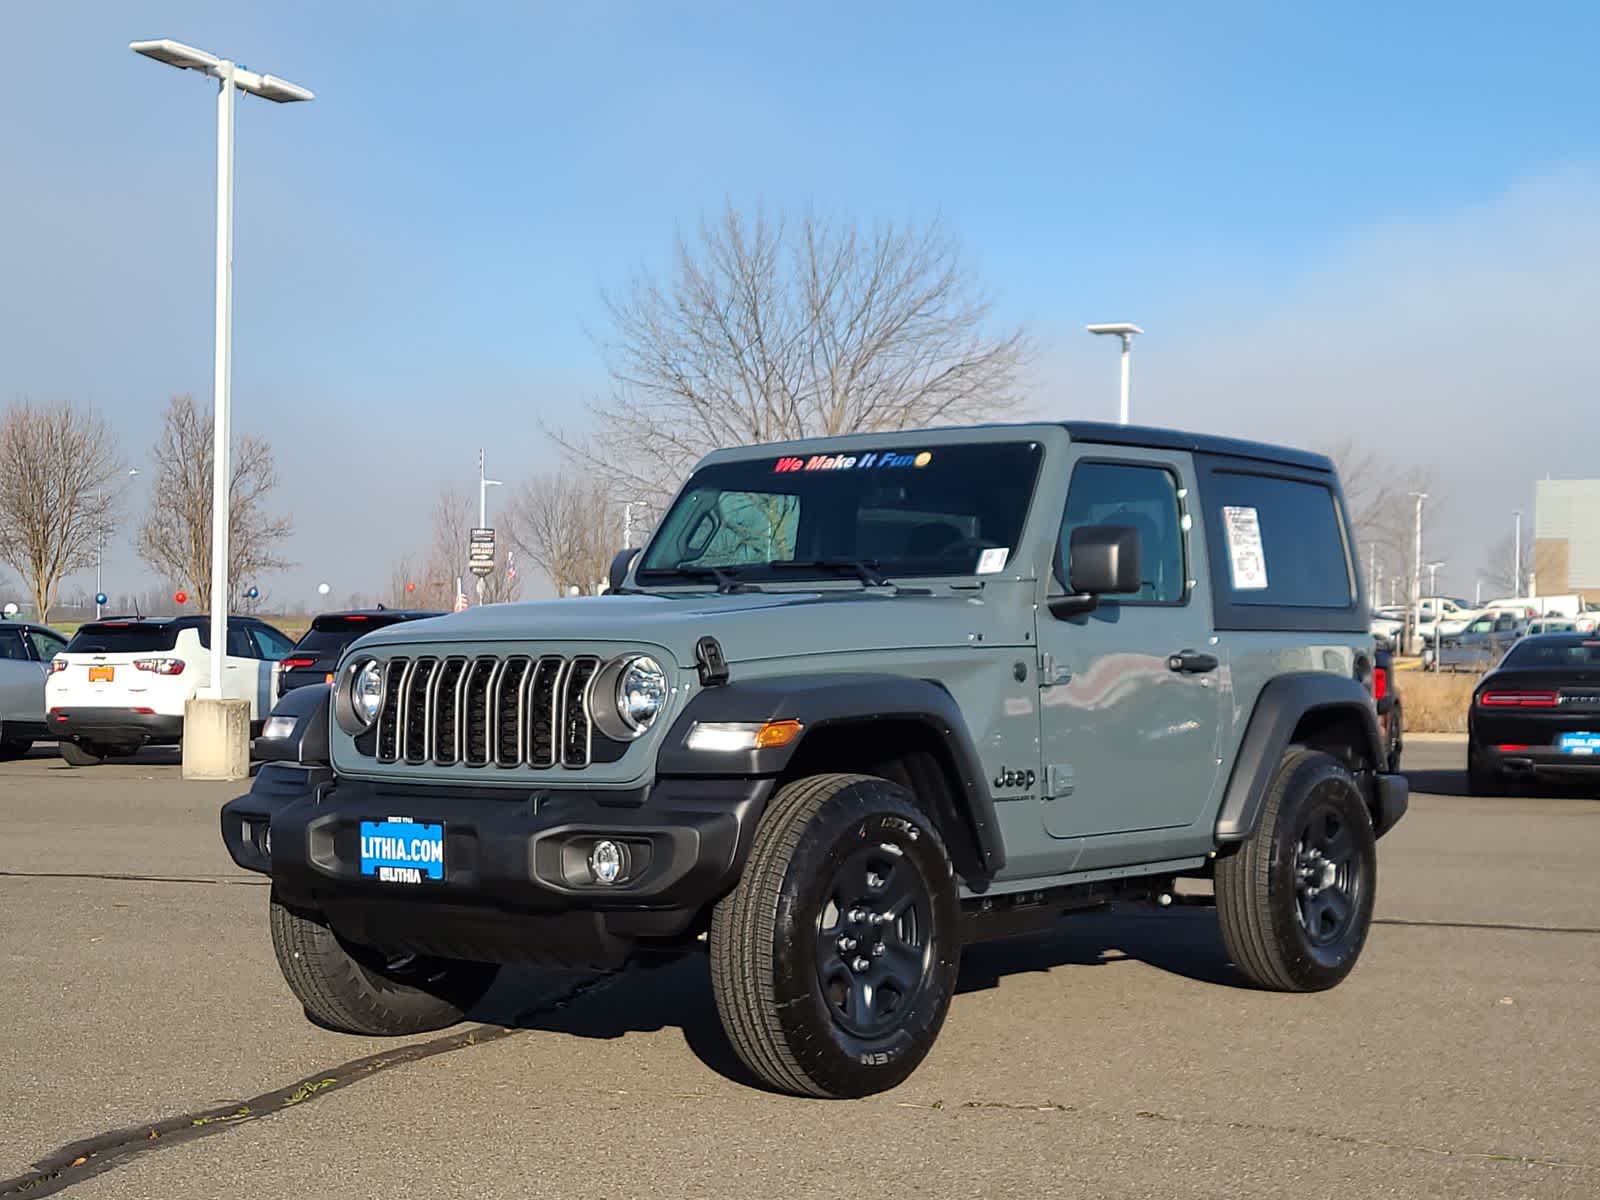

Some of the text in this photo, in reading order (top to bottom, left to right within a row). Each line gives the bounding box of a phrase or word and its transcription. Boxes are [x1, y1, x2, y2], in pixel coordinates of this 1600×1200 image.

[774, 452, 915, 473] We Make It Fun
[993, 765, 1036, 791] Jeep
[361, 836, 443, 864] LITHIA.COM
[389, 867, 422, 884] LITHIA
